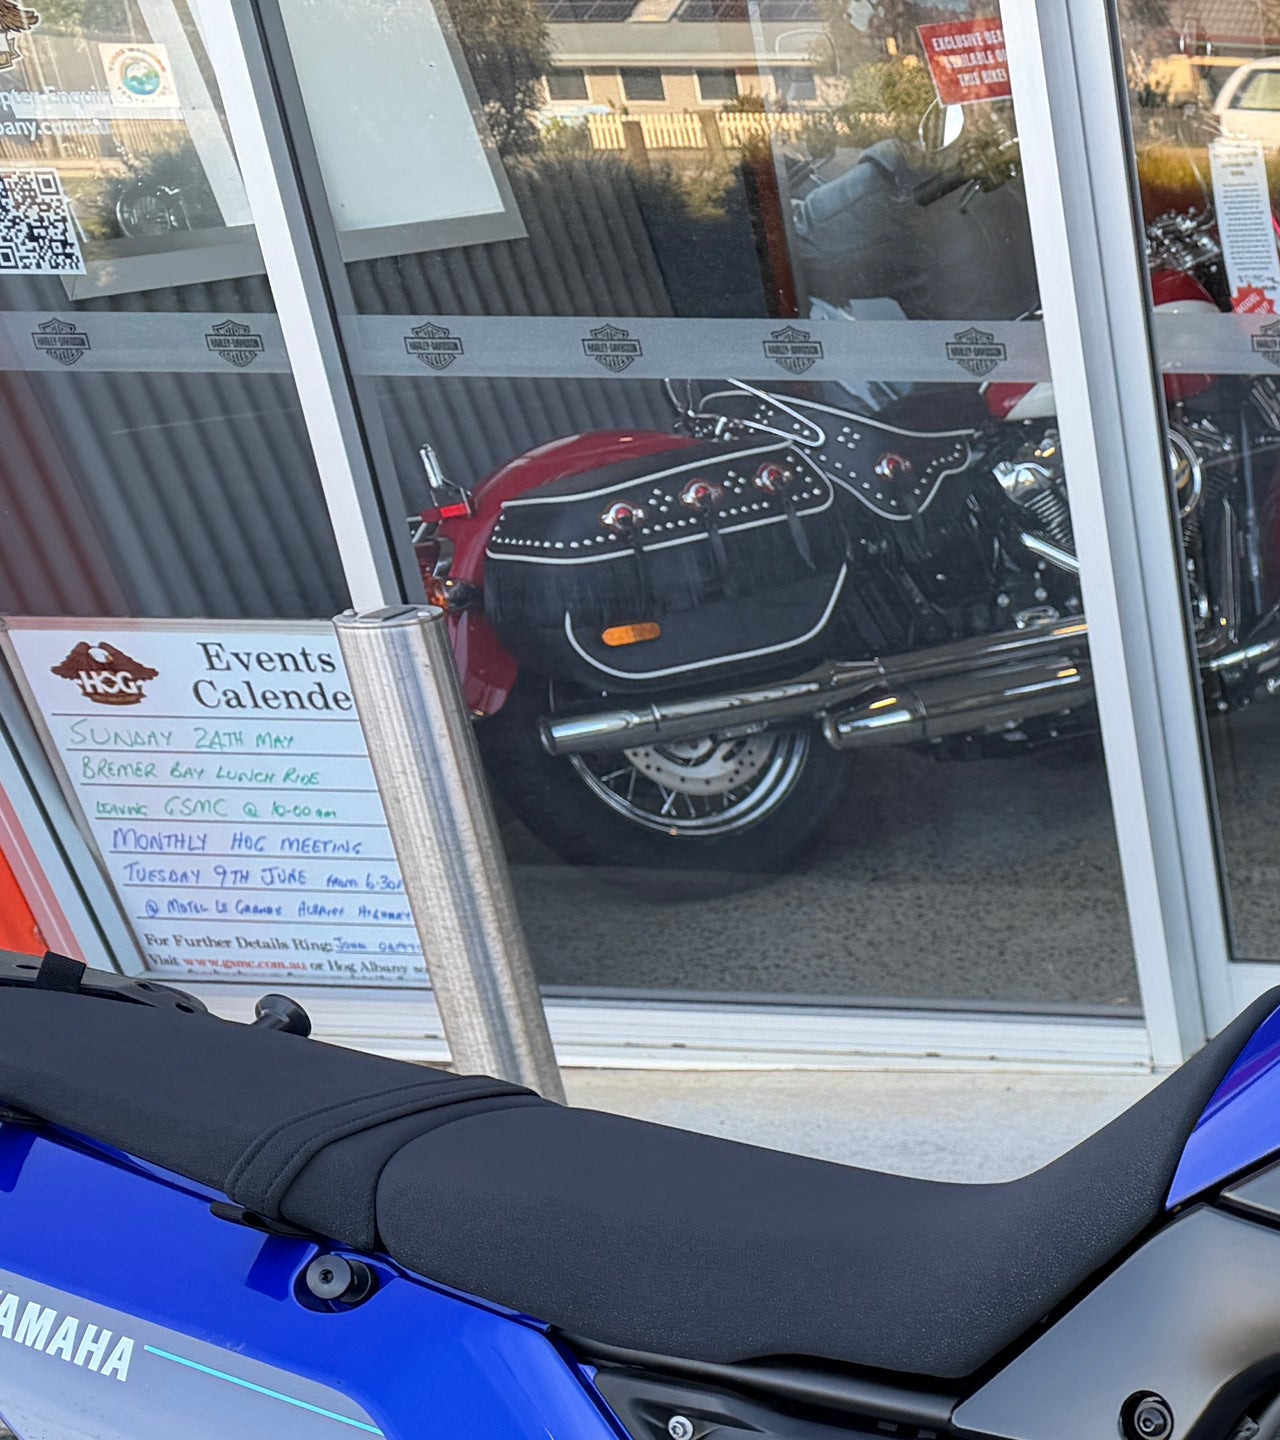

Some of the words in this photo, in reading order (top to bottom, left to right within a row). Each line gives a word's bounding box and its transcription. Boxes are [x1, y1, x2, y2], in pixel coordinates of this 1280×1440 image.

[197, 642, 337, 673] Events
[79, 669, 138, 695] HOG
[192, 679, 353, 711] Calende
[70, 718, 172, 747] SUNDAY
[255, 729, 295, 749] MAY
[81, 755, 158, 780] BREMER
[169, 760, 204, 780] BAY
[216, 764, 275, 783] LUNCH
[282, 767, 321, 786] RIDE
[164, 795, 229, 817] GSMC
[112, 827, 208, 851] MONTHLY
[230, 832, 267, 852] HOG
[280, 836, 363, 855] MEETING
[123, 860, 201, 884] TUESDAY
[213, 864, 250, 888] 9TH
[261, 865, 307, 885] JUNE
[144, 933, 169, 947] For
[173, 933, 232, 949] Further
[235, 935, 290, 951] Details
[149, 953, 180, 967] Visit
[0, 1290, 135, 1382] AMAHA
